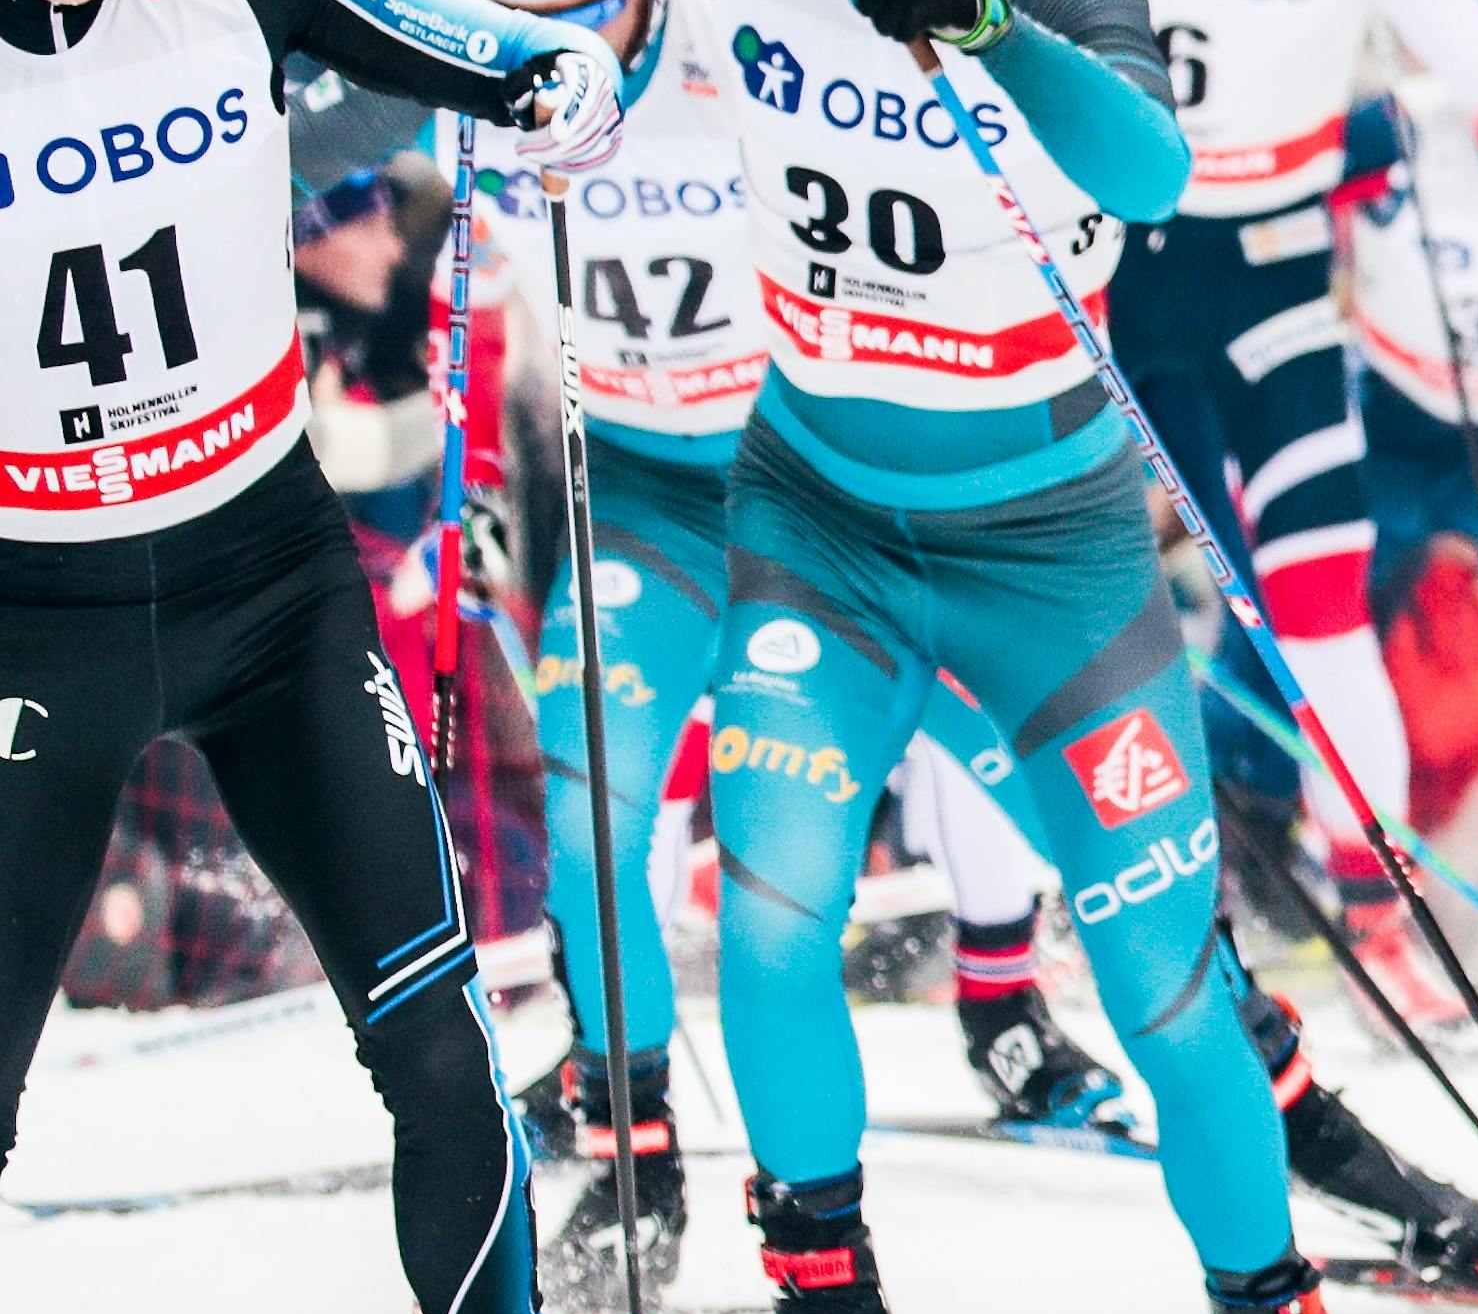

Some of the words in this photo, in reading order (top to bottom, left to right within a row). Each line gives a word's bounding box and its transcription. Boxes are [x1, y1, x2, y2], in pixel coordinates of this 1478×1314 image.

[36, 88, 248, 194] OBOS
[822, 78, 1008, 149] OBOS
[786, 166, 946, 276] 30
[36, 224, 198, 387] 41
[584, 256, 732, 342] 42
[777, 294, 994, 370] VIESSMANN
[107, 384, 199, 418] HOLMENKOLLEN
[109, 404, 182, 432] SKIFESTIVAL
[5, 402, 256, 505] VIESSMANN
[713, 725, 862, 805] omfy
